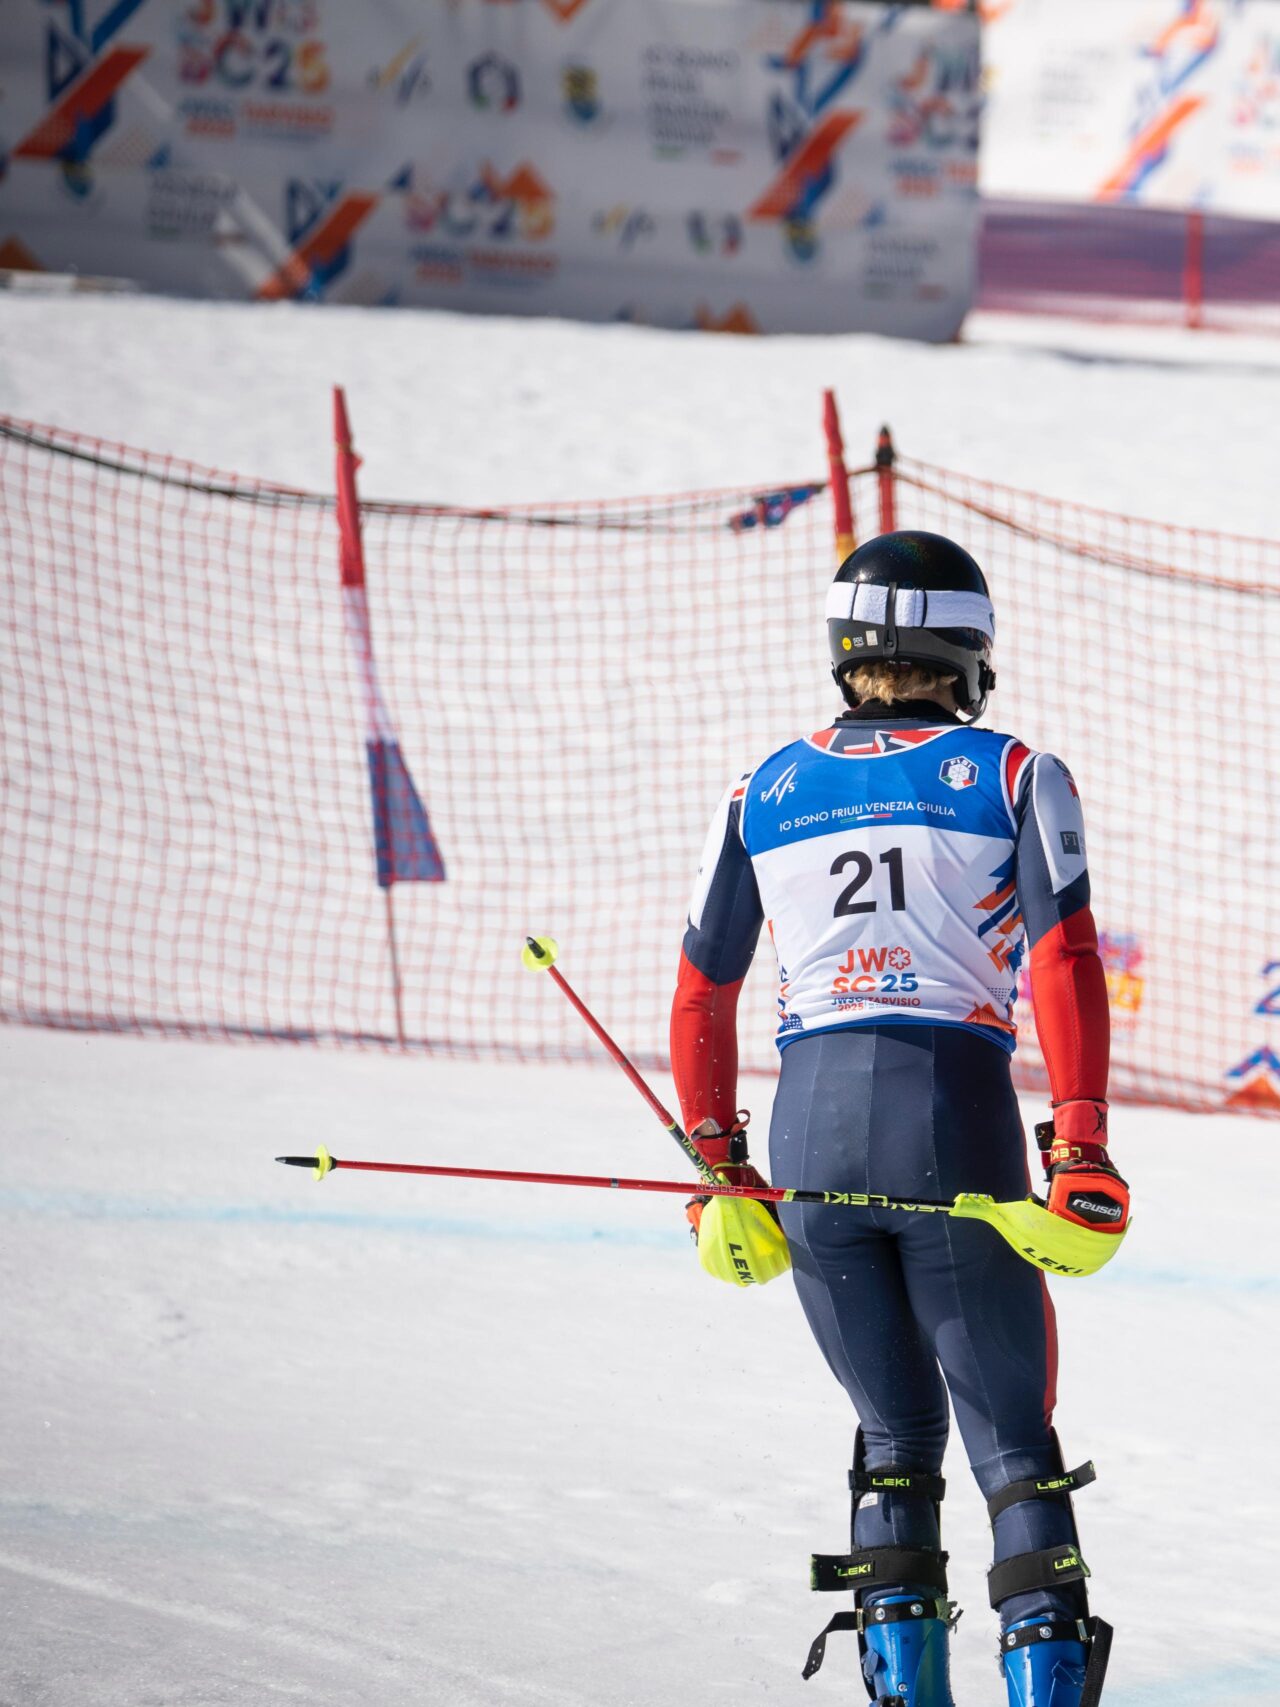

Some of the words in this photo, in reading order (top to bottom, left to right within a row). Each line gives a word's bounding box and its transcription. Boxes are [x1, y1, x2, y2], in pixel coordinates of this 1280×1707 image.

[780, 821, 791, 832] IO
[794, 811, 829, 828] SONO
[832, 804, 863, 819] FRIULI
[865, 801, 915, 814] VENEZIA
[917, 801, 956, 817] GIULIA
[830, 847, 906, 918] 21
[824, 1192, 888, 1207] LEKI
[1072, 1197, 1123, 1219] reusch
[728, 1242, 757, 1284] LEKI
[1021, 1247, 1085, 1274] LEKI
[872, 1478, 910, 1487] LEKI
[1037, 1475, 1074, 1491] LEKI
[837, 1564, 871, 1577] LEKI
